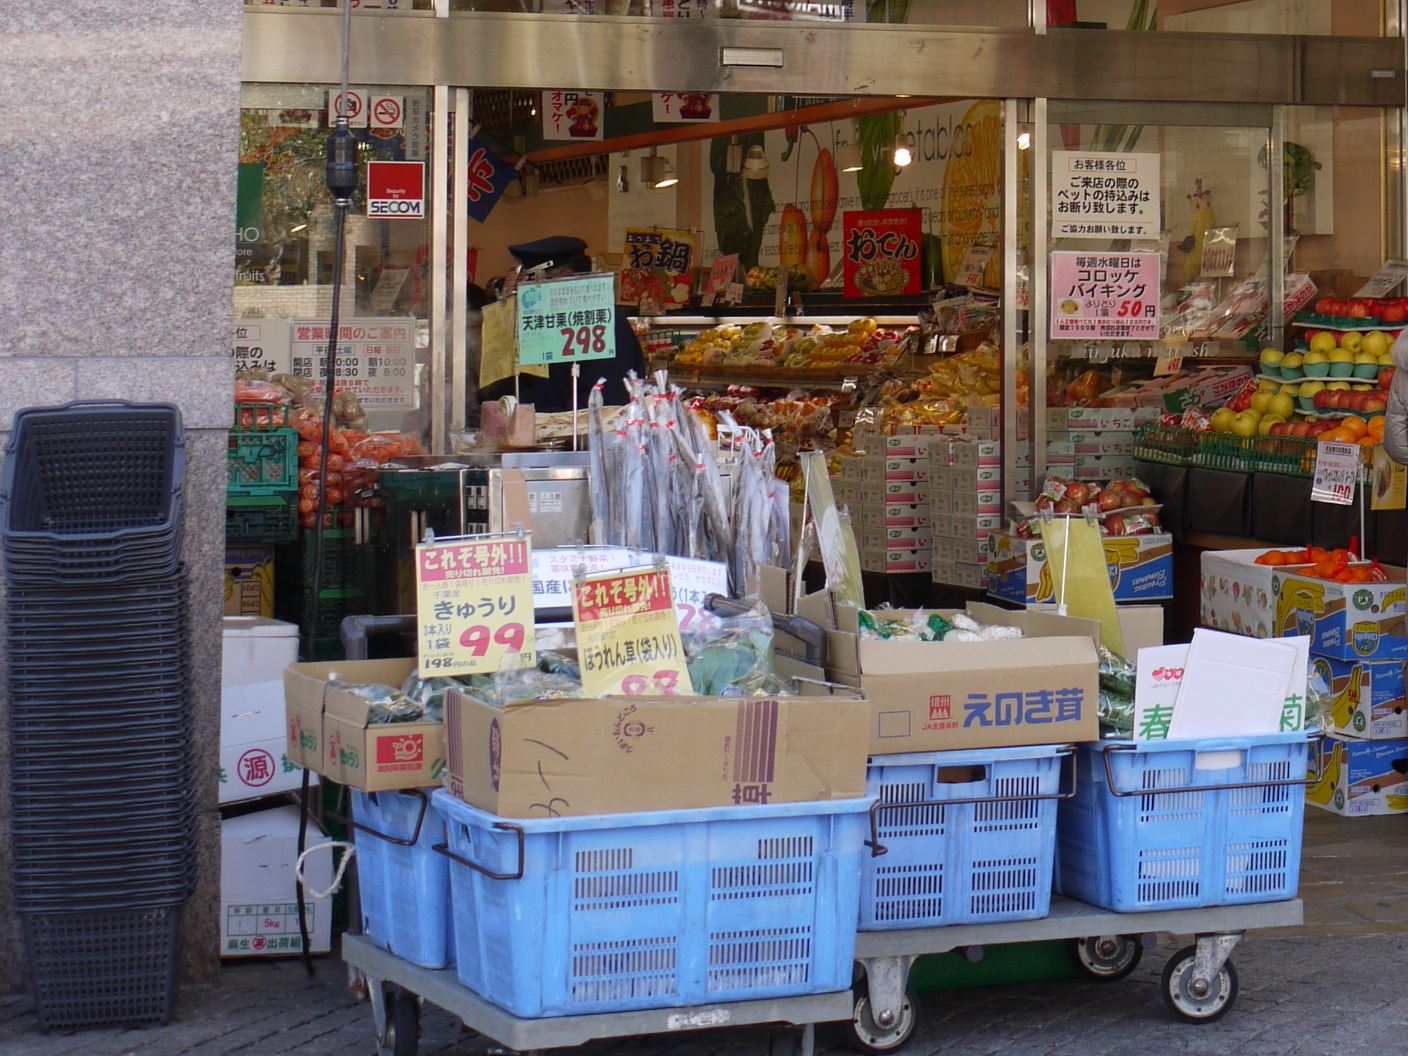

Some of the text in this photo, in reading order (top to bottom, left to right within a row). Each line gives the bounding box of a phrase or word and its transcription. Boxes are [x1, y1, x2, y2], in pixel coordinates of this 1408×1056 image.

[1074, 158, 1127, 171] お客様各位
[1070, 176, 1139, 189] ご来店の際の
[1057, 189, 1151, 202] ペットの持込みは
[371, 200, 420, 214] SECOM
[1057, 201, 1144, 215] お断り致します。
[1061, 224, 1147, 235] ご協力お願い致します。
[846, 228, 919, 263] おでん
[629, 238, 692, 276] お鍋
[1075, 256, 1142, 269] 毎週水曜日は
[1077, 269, 1140, 284] コロッケ
[1068, 283, 1147, 298] バイキング
[1116, 299, 1156, 318] 50 円
[522, 308, 612, 331] 天津甘栗(焼割栗)
[560, 324, 607, 357] 298
[1101, 417, 1133, 429] いちご
[1101, 443, 1133, 454] いちご
[1101, 466, 1133, 478] いちご
[424, 542, 523, 571] これぞ号外!!
[549, 554, 616, 564] スタミナ野菜!
[445, 566, 505, 580] 売り切れ御免!
[580, 574, 668, 609] これぞ号外!!
[433, 594, 516, 621] きゅうり
[423, 623, 452, 637] 3本入り
[427, 637, 451, 650] 1袋
[459, 622, 525, 657] 99
[584, 633, 678, 672] ほうれん草(袋入り)
[930, 696, 950, 708] 信州
[963, 687, 1085, 728] えのき茸
[1138, 703, 1174, 741] 春
[243, 754, 270, 782] 源
[264, 918, 281, 929] 5kg
